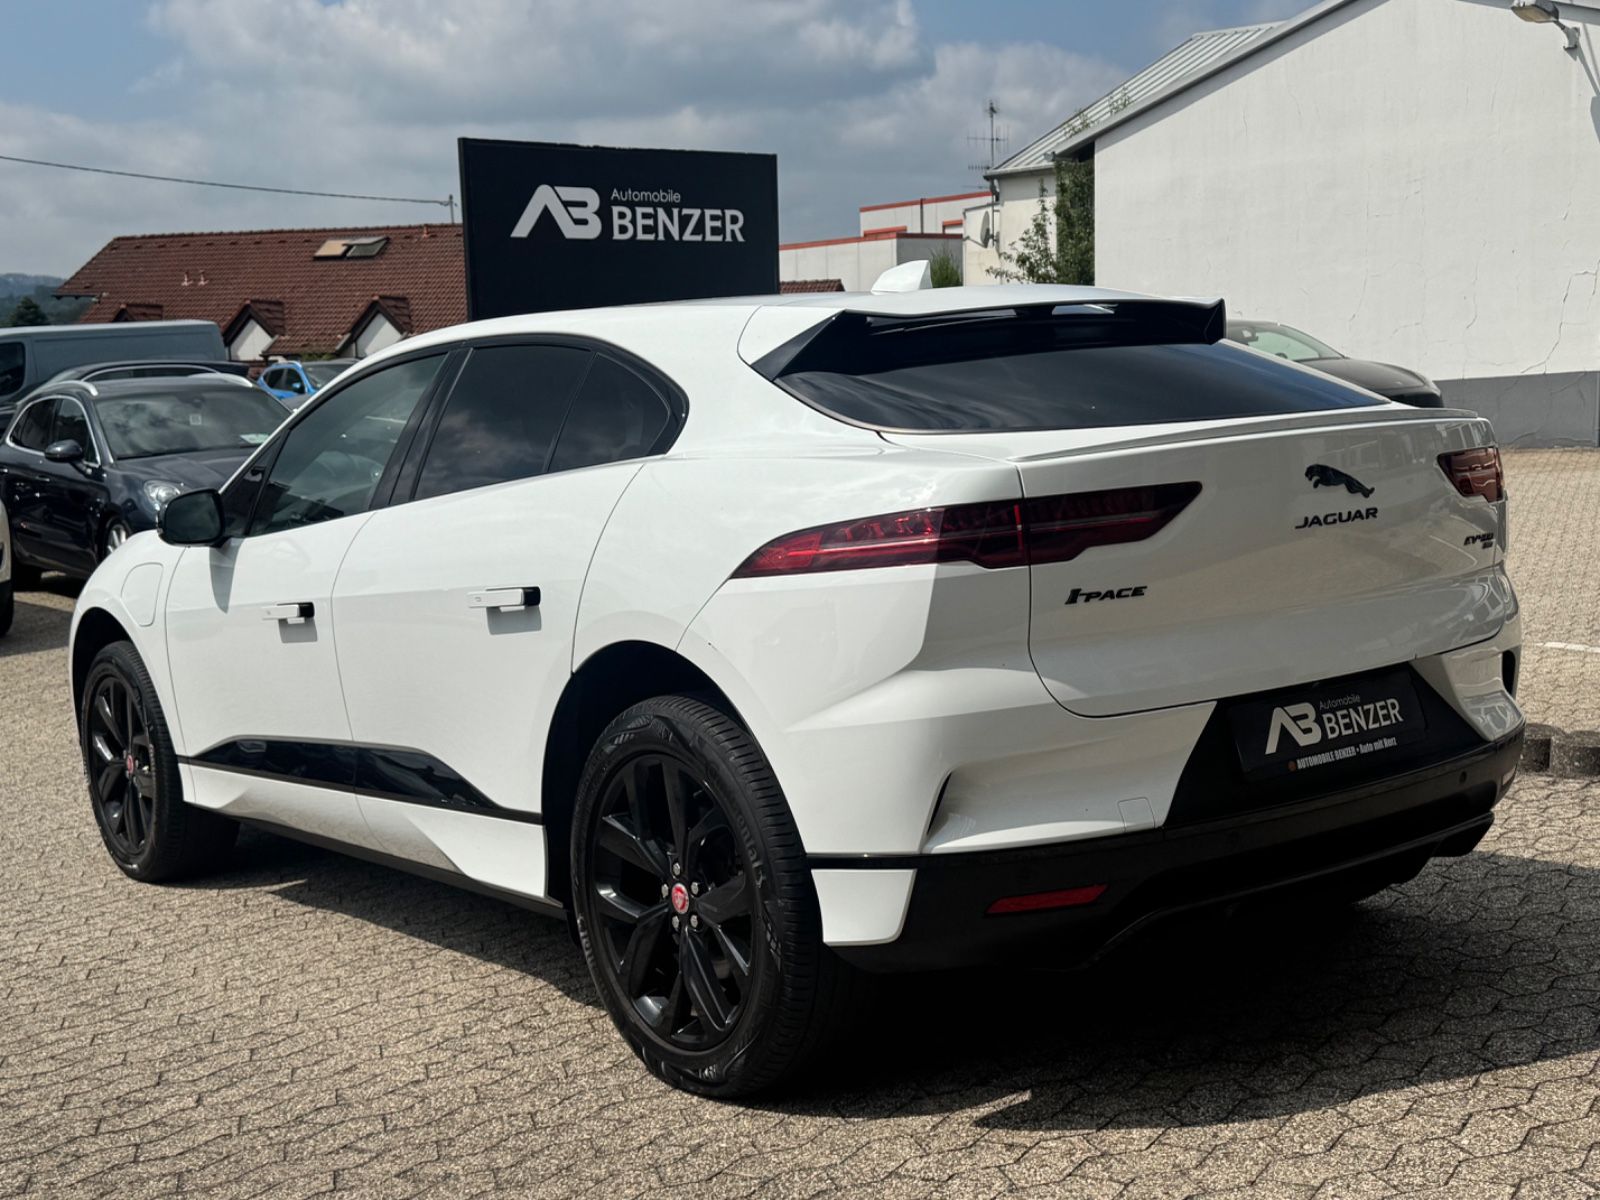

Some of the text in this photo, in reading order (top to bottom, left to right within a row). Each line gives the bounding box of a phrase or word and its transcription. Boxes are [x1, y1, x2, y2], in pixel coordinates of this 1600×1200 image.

[611, 188, 681, 203] Automobile
[610, 205, 745, 242] BENZER
[1295, 507, 1378, 529] JAGUAR
[1319, 694, 1361, 711] Automobile
[1322, 698, 1404, 739] BENZER
[1297, 750, 1334, 770] AUTOMOBILE
[1334, 745, 1357, 760] BENZER
